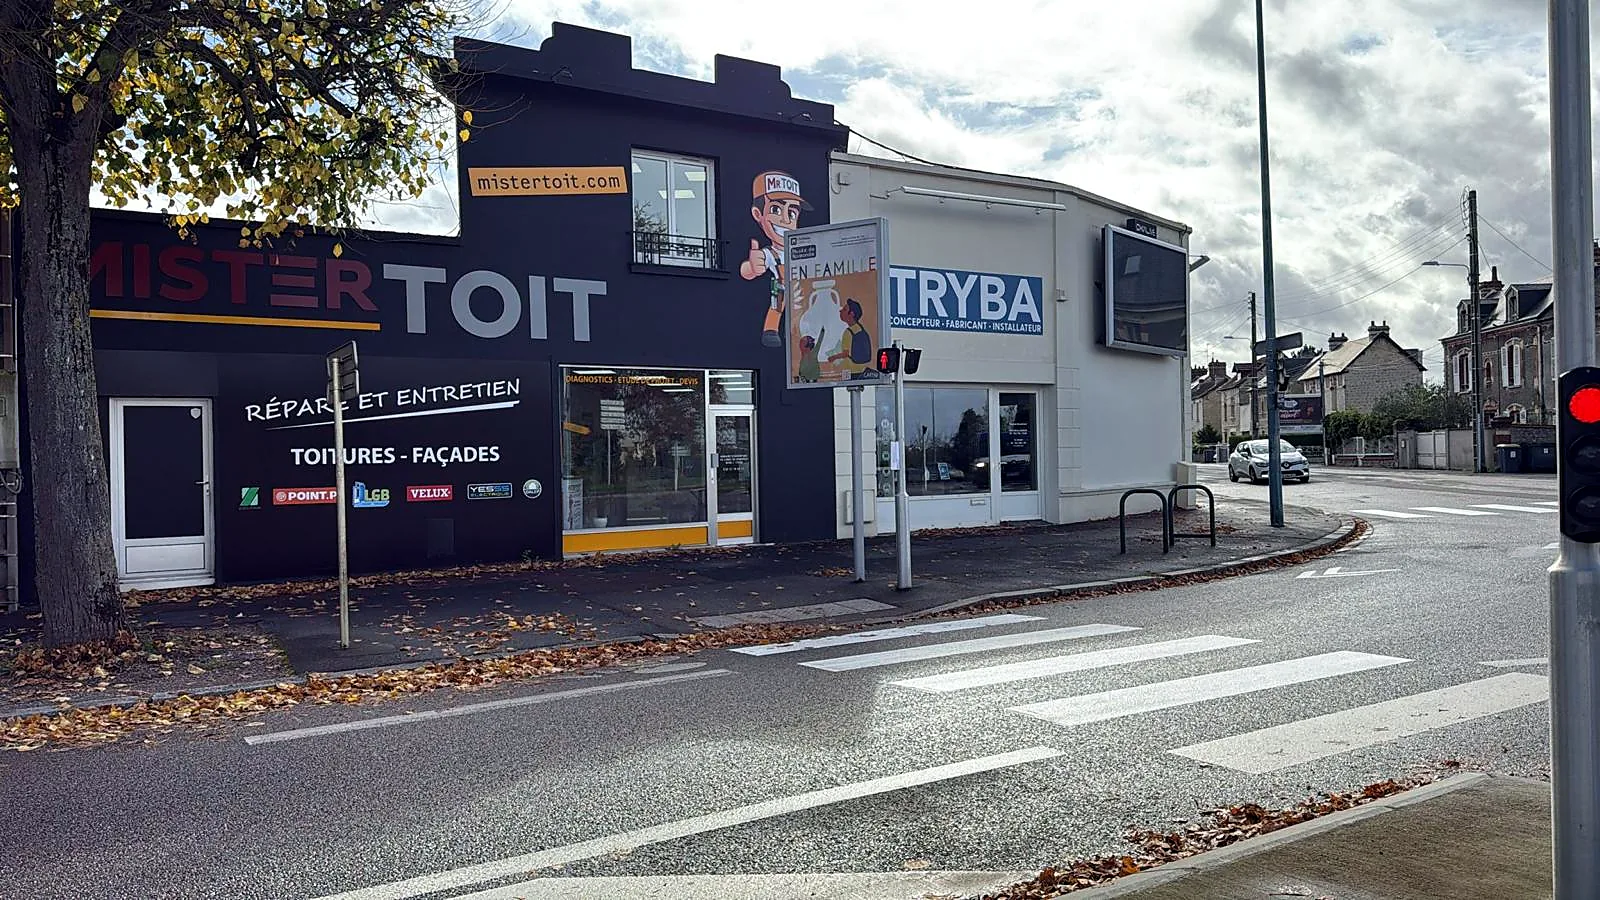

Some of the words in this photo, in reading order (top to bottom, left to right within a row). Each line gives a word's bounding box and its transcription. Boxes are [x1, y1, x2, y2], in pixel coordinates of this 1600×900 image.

[478, 173, 620, 190] mistertoit.com
[781, 177, 798, 194] TOIT
[791, 265, 808, 280] EN
[383, 263, 607, 342] TOIT
[889, 268, 1041, 322] TRYBA
[946, 319, 987, 331] FABRICANT
[992, 322, 1042, 333] INSTALLATEUR
[565, 375, 613, 384] DIAGNOSTICS
[680, 377, 698, 385] DEVIS
[359, 392, 388, 410] ET
[397, 378, 520, 406] ENTRETIEN
[290, 447, 396, 465] TOITURES
[412, 446, 501, 467] FAÇADES
[288, 490, 337, 501] POINT.P
[364, 489, 390, 501] LGB
[411, 488, 449, 499] VELUX
